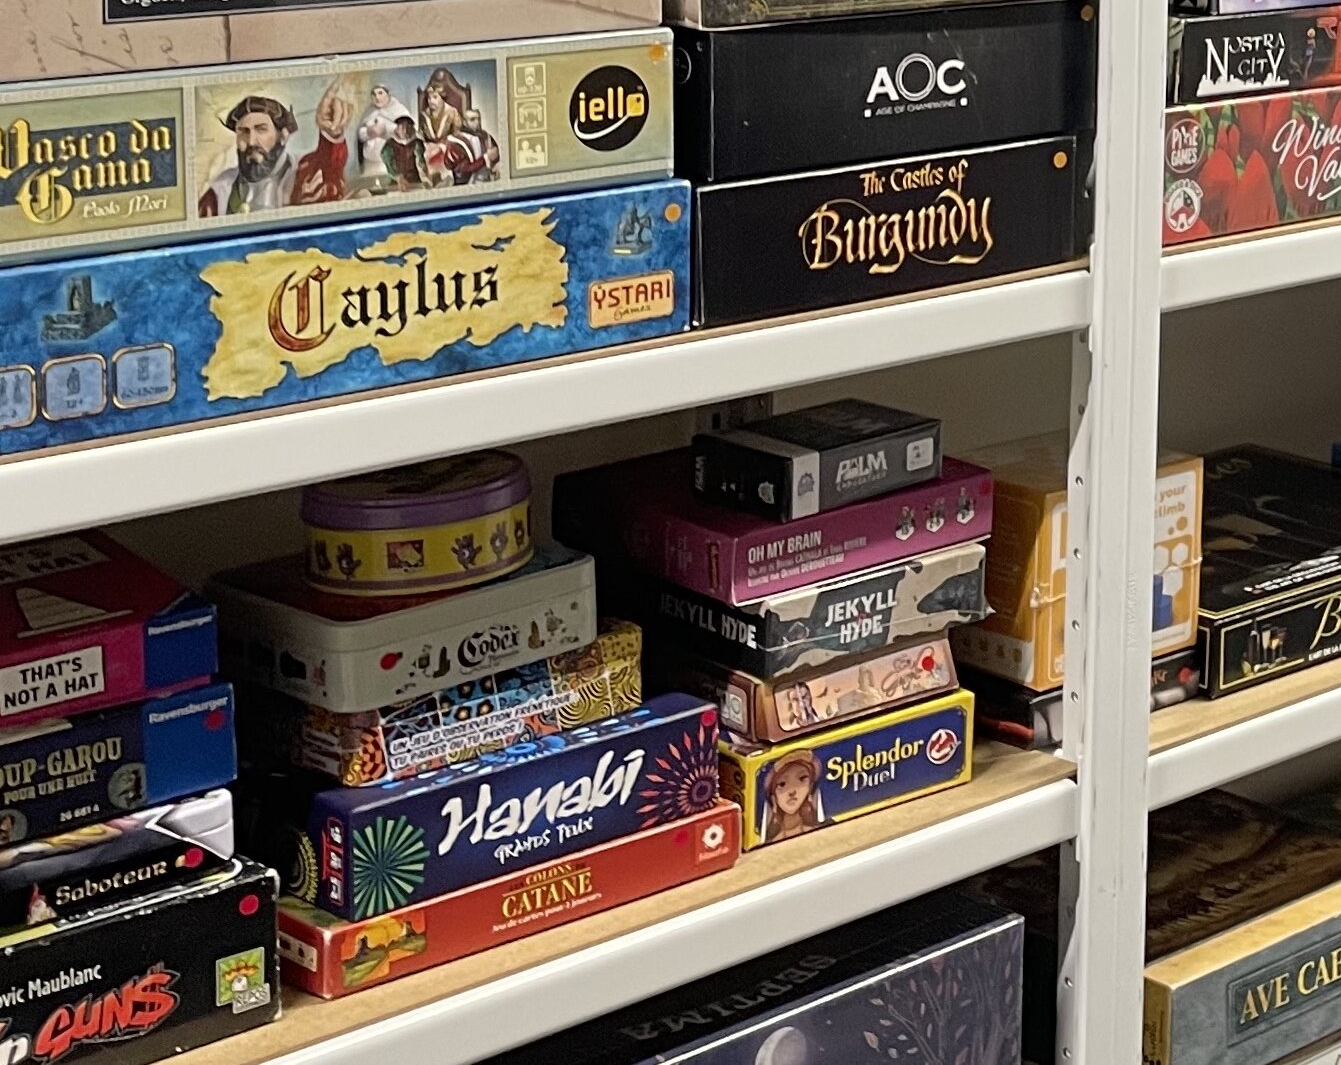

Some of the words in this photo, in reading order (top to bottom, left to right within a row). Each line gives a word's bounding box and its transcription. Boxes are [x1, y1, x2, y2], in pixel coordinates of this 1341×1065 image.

[866, 52, 967, 104] AOC
[577, 87, 646, 122] iello
[876, 105, 893, 116] AGE
[895, 104, 906, 114] OF
[126, 115, 174, 153] da
[1171, 148, 1198, 166] GAMES
[15, 155, 153, 225] Gama
[860, 172, 885, 196] The
[890, 164, 944, 192] Castles
[948, 159, 969, 192] of
[127, 192, 168, 217] Mori
[799, 188, 993, 275] Burgundy
[267, 256, 501, 354] Caylus
[1159, 485, 1186, 503] your
[748, 547, 765, 564] OH
[767, 541, 784, 561] MY
[787, 530, 822, 553] BRAIN
[660, 593, 716, 633] JEKYLL
[721, 616, 758, 648] HYDE
[824, 589, 898, 627] JEKYLL
[840, 615, 884, 645] HYDE
[19, 657, 83, 684] THAT'S
[4, 688, 42, 709] NOT
[46, 682, 58, 697] A
[64, 673, 99, 693] HAT
[411, 734, 429, 746] JEU
[826, 737, 924, 789] Splendor
[853, 763, 896, 792] Duel
[437, 748, 645, 856] Hanabi
[55, 859, 169, 906] Saboteur
[502, 871, 593, 919] CATANE
[28, 965, 102, 1000] Maublanc
[621, 955, 838, 1041] SEPTIMA
[1240, 971, 1291, 1026] AVE
[34, 973, 177, 1059] GUNS
